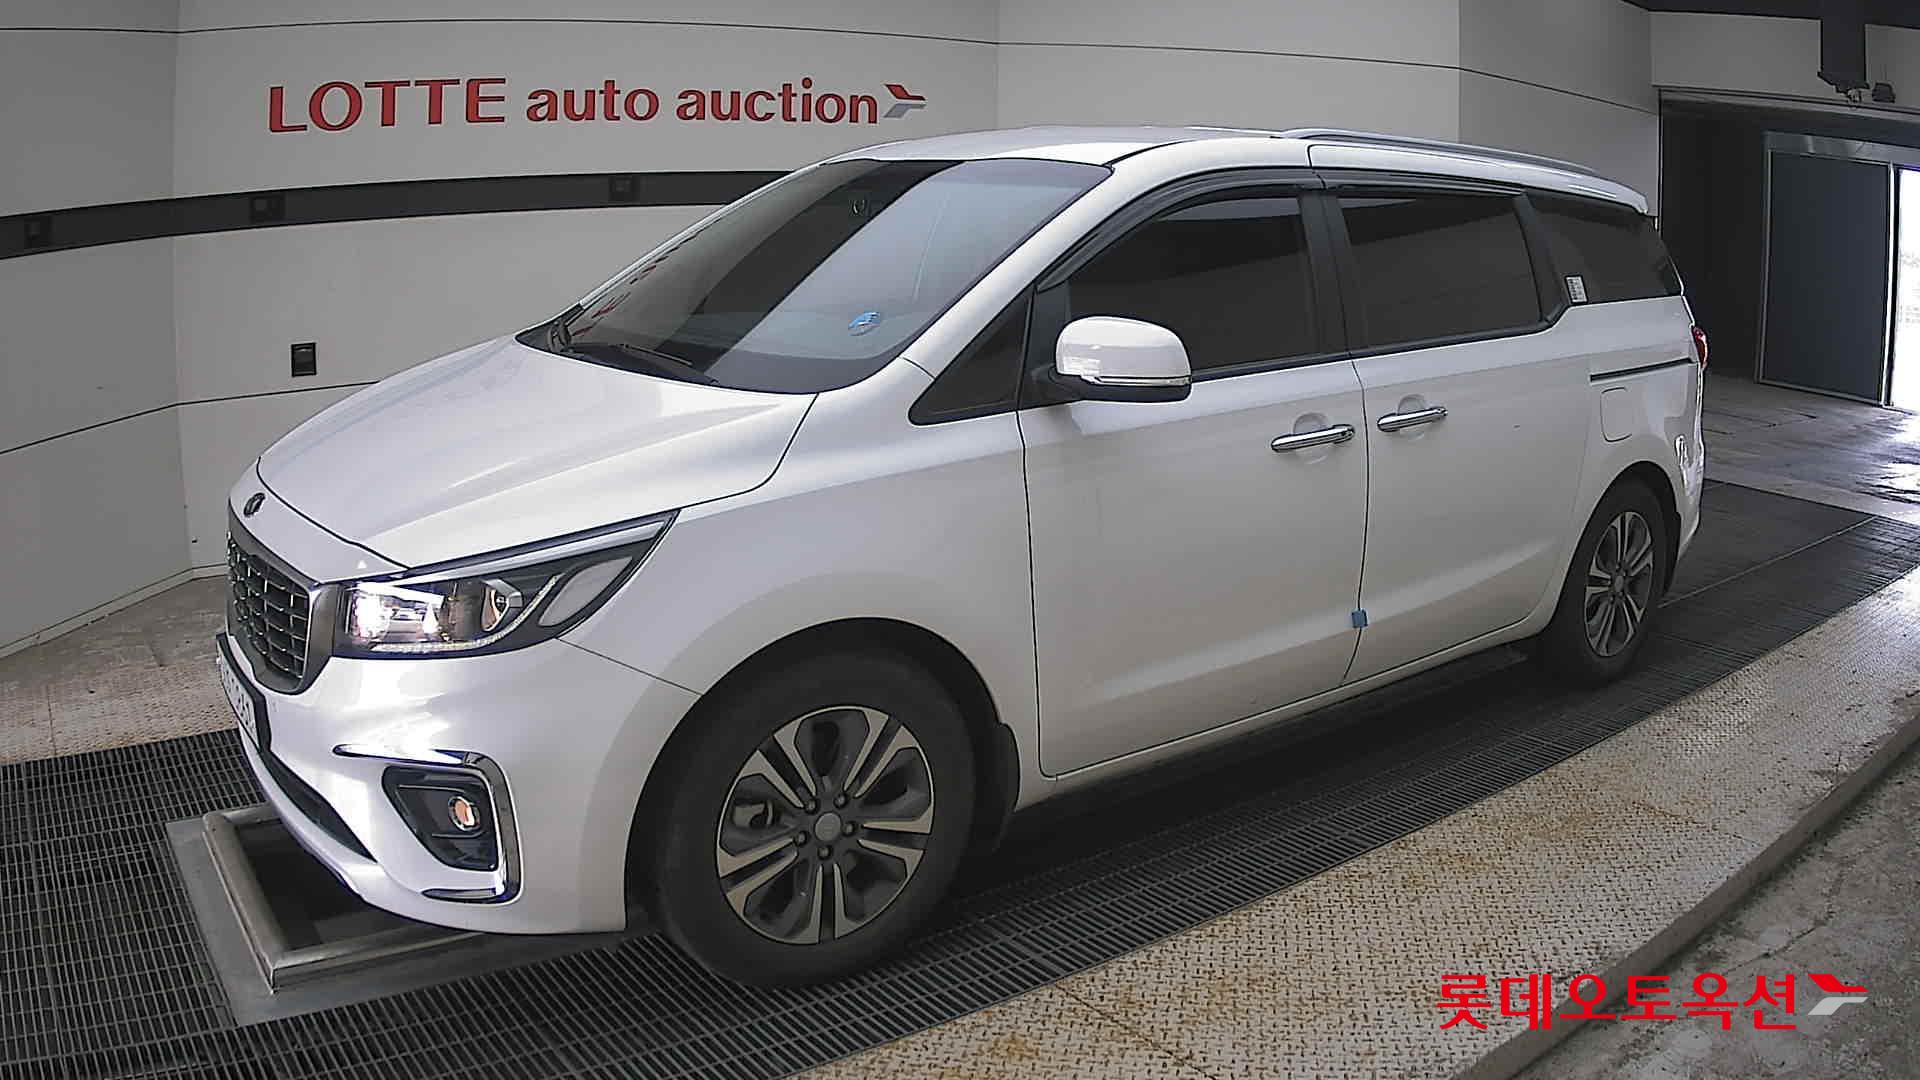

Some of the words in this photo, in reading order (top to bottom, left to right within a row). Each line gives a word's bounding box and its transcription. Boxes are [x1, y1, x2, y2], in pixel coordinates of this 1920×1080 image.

[270, 78, 505, 132] LOTTE
[527, 80, 659, 121] auto
[676, 78, 878, 123] auction
